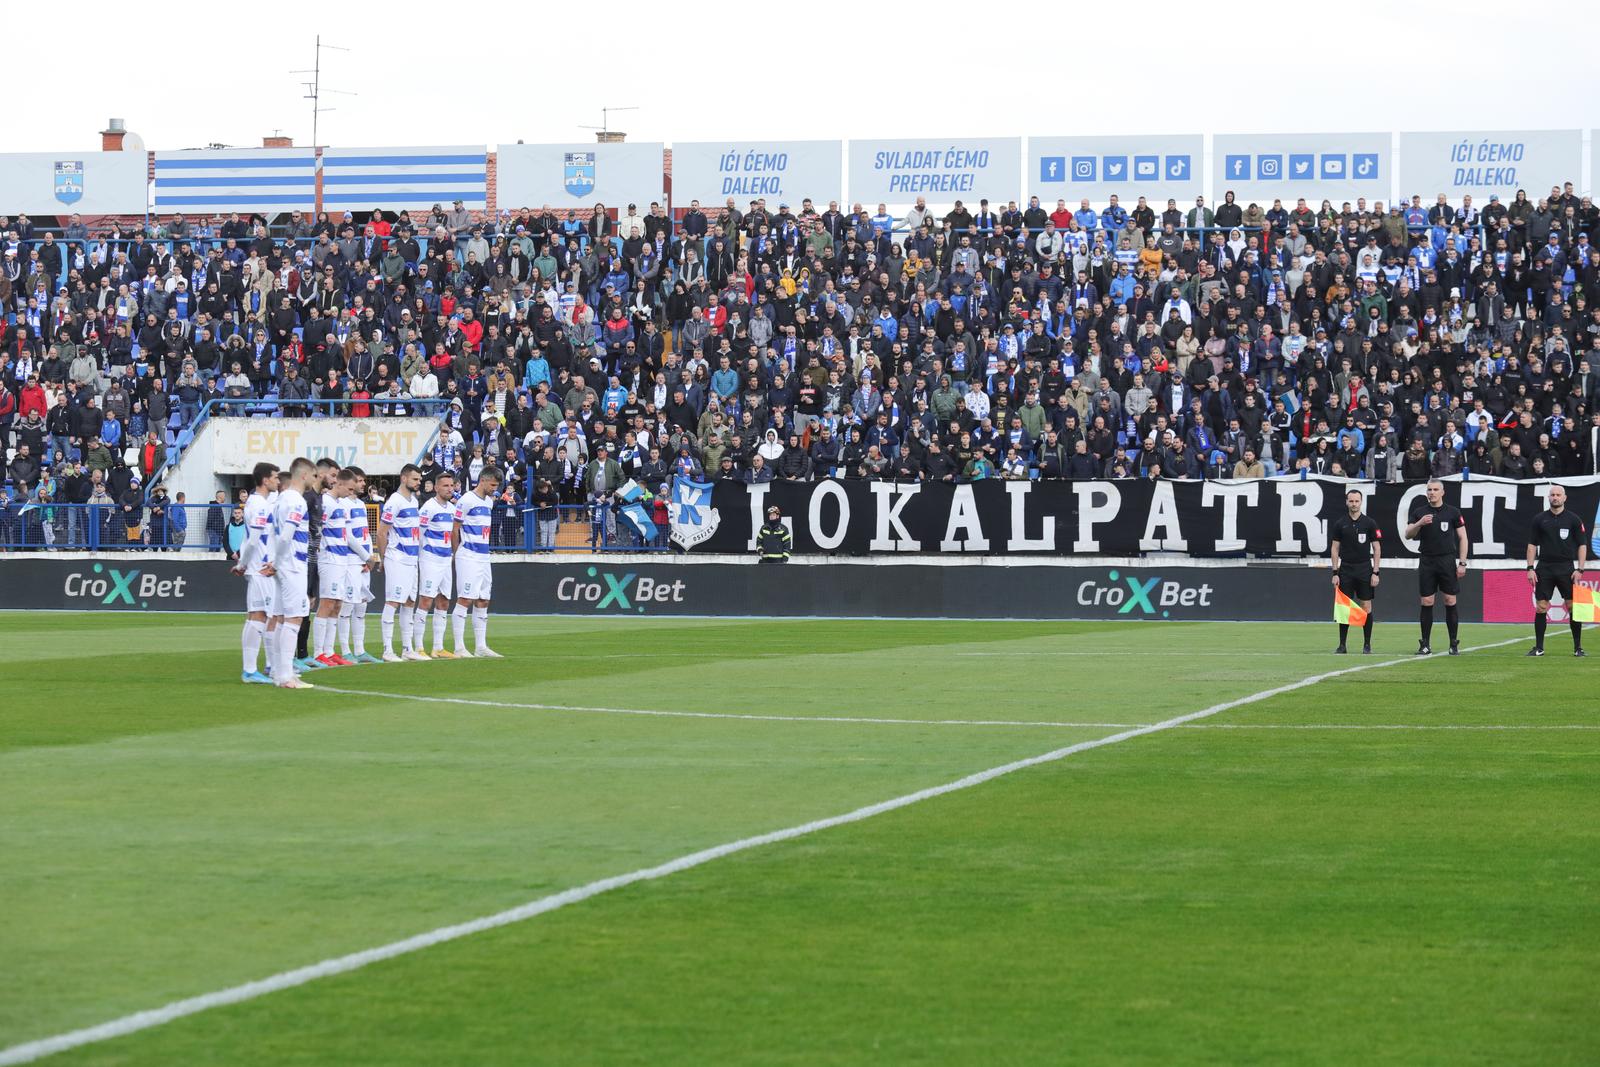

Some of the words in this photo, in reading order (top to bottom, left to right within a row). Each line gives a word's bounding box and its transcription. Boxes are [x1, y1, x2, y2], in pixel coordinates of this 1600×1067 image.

[720, 150, 740, 172] IĆI
[744, 149, 788, 171] ĆEMO
[874, 151, 943, 170] SVLADAT
[944, 146, 989, 168] ĆEMO
[1450, 139, 1473, 162] IĆI
[1477, 139, 1524, 162] ĆEMO
[722, 176, 783, 196] DALEKO,
[889, 174, 975, 193] PREPREKE!
[1453, 167, 1519, 188] DALEKO,
[247, 430, 301, 455] EXIT
[363, 431, 418, 455] EXIT
[678, 484, 703, 525] K
[64, 569, 187, 604] CroXBet
[557, 573, 686, 609] CroXBet
[1076, 577, 1214, 613] CroXBet
